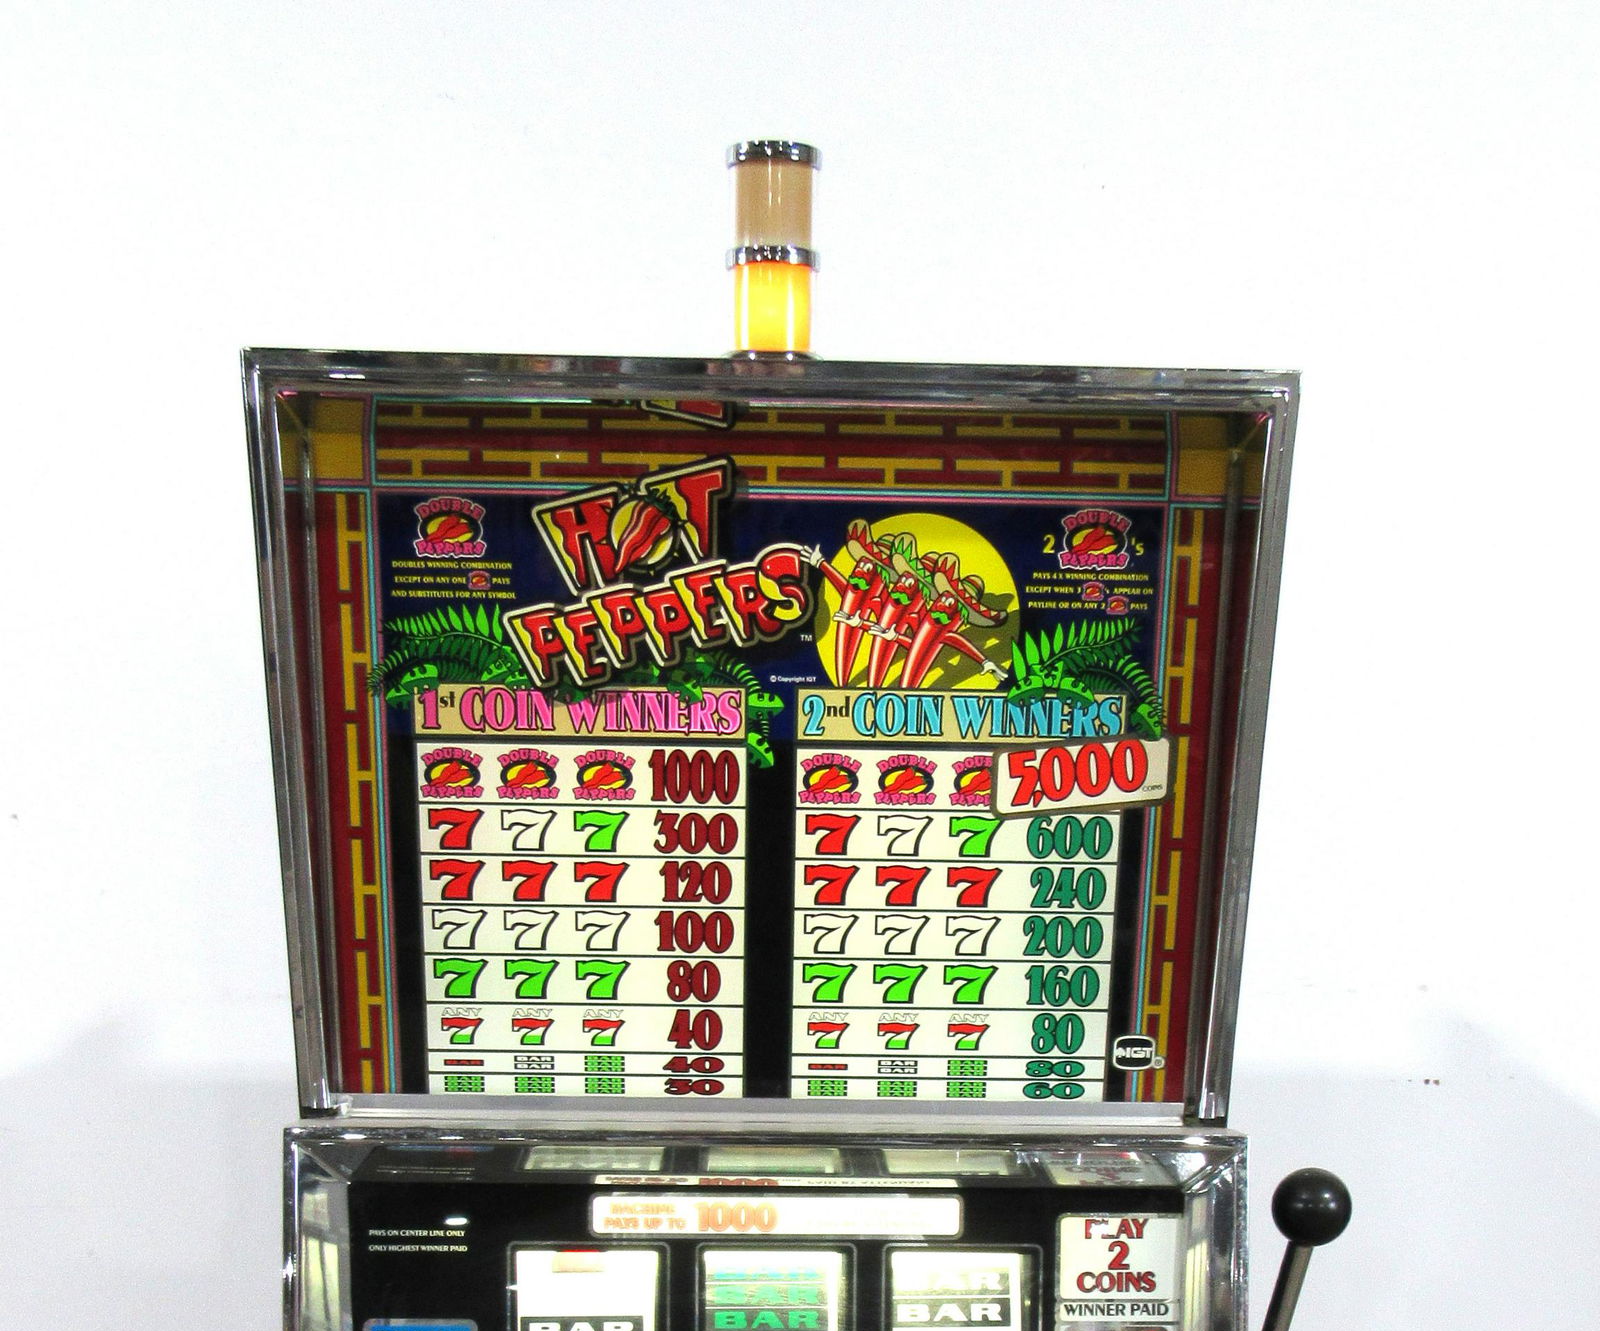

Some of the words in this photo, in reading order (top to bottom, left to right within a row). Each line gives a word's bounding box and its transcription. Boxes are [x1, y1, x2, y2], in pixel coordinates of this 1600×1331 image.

[415, 497, 485, 519] DOUBLE
[533, 461, 730, 595] HOT
[1062, 509, 1131, 532] DOUBLE
[415, 540, 485, 556] PEPPERS
[1042, 534, 1055, 554] 2
[392, 561, 425, 569] DOUBLES
[427, 561, 459, 569] WINNING
[460, 562, 512, 570] COMBINATION
[1060, 552, 1128, 567] PEPPERS
[394, 576, 421, 584] EXCEPT
[423, 576, 434, 584] ON
[1033, 572, 1051, 580] PAYS
[1065, 573, 1097, 581] WINNING
[1098, 573, 1149, 581] COMBINATION
[391, 590, 407, 598] AND
[408, 591, 454, 599] SUBSTITUTES
[455, 591, 470, 599] FOR
[488, 592, 516, 600] SYMBOL
[1053, 586, 1074, 594] WHEN
[1113, 587, 1141, 595] APPEAR
[504, 543, 808, 686] PEPPERS
[1028, 601, 1057, 609] PAYLINE
[419, 687, 456, 730] 1st
[459, 686, 554, 731] COIN
[567, 691, 741, 735] WINNERS
[803, 693, 850, 738] 2nd
[852, 692, 944, 738] COIN
[951, 694, 1123, 739] WINNERS
[420, 747, 483, 768] DOUBLE
[800, 753, 862, 774] DOUBLE
[649, 749, 740, 804] 1000
[420, 785, 483, 800] PEPPERS
[799, 791, 861, 806] PEPPERS
[428, 808, 485, 850] 7
[501, 809, 557, 851] 7
[574, 811, 629, 852] 7
[654, 810, 739, 855] 300
[1026, 815, 1113, 860] 600
[430, 859, 486, 900] 7
[502, 860, 558, 901] 7
[574, 861, 630, 902] 7
[660, 860, 733, 904] 120
[1030, 866, 1107, 911] 240
[654, 910, 734, 954] 100
[1023, 915, 1103, 958] 200
[666, 959, 721, 1003] 80
[1025, 965, 1100, 1007] 160
[667, 1009, 723, 1051] 40
[1031, 1013, 1085, 1054] 80
[663, 1056, 724, 1073] 40
[1025, 1060, 1085, 1077] 80
[1023, 1082, 1085, 1099] 60
[604, 1217, 639, 1230] PAYS
[643, 1217, 663, 1230] UP
[666, 1218, 686, 1230] TO
[697, 1202, 778, 1232] 1000
[369, 1244, 387, 1252] ONLY
[388, 1244, 419, 1252] HIGHEST
[1108, 1241, 1130, 1270] 2
[1076, 1271, 1157, 1293] COINS
[714, 1311, 819, 1329] BAR
[896, 1303, 1002, 1323] BAR
[1064, 1303, 1125, 1316] WINNER
[1131, 1303, 1169, 1316] PAID
